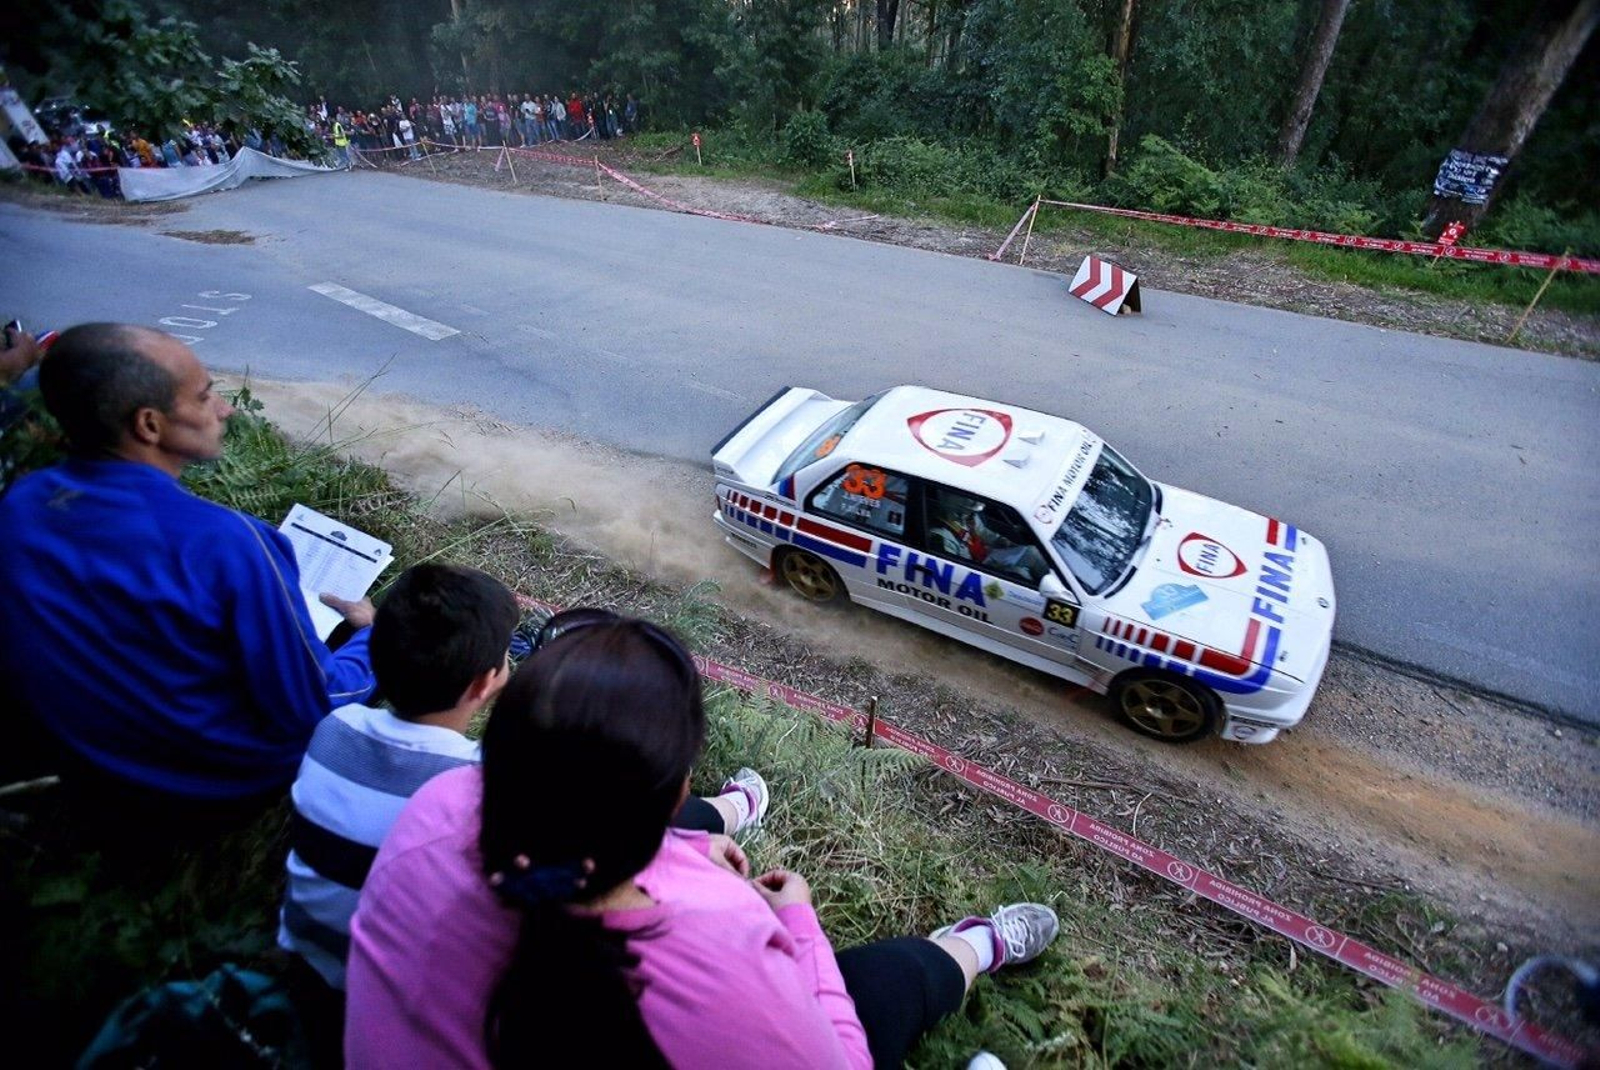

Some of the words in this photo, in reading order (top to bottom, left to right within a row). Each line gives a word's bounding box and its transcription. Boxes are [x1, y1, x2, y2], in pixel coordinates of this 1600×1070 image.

[936, 412, 987, 450] FINA
[1047, 485, 1068, 512] FINA
[1080, 440, 1093, 456] OIL
[876, 543, 987, 608] FINA
[1196, 543, 1219, 574] FINA
[876, 577, 952, 609] MOTOR
[957, 604, 994, 625] OIL
[1251, 551, 1295, 624] FINA
[1047, 603, 1074, 625] 33
